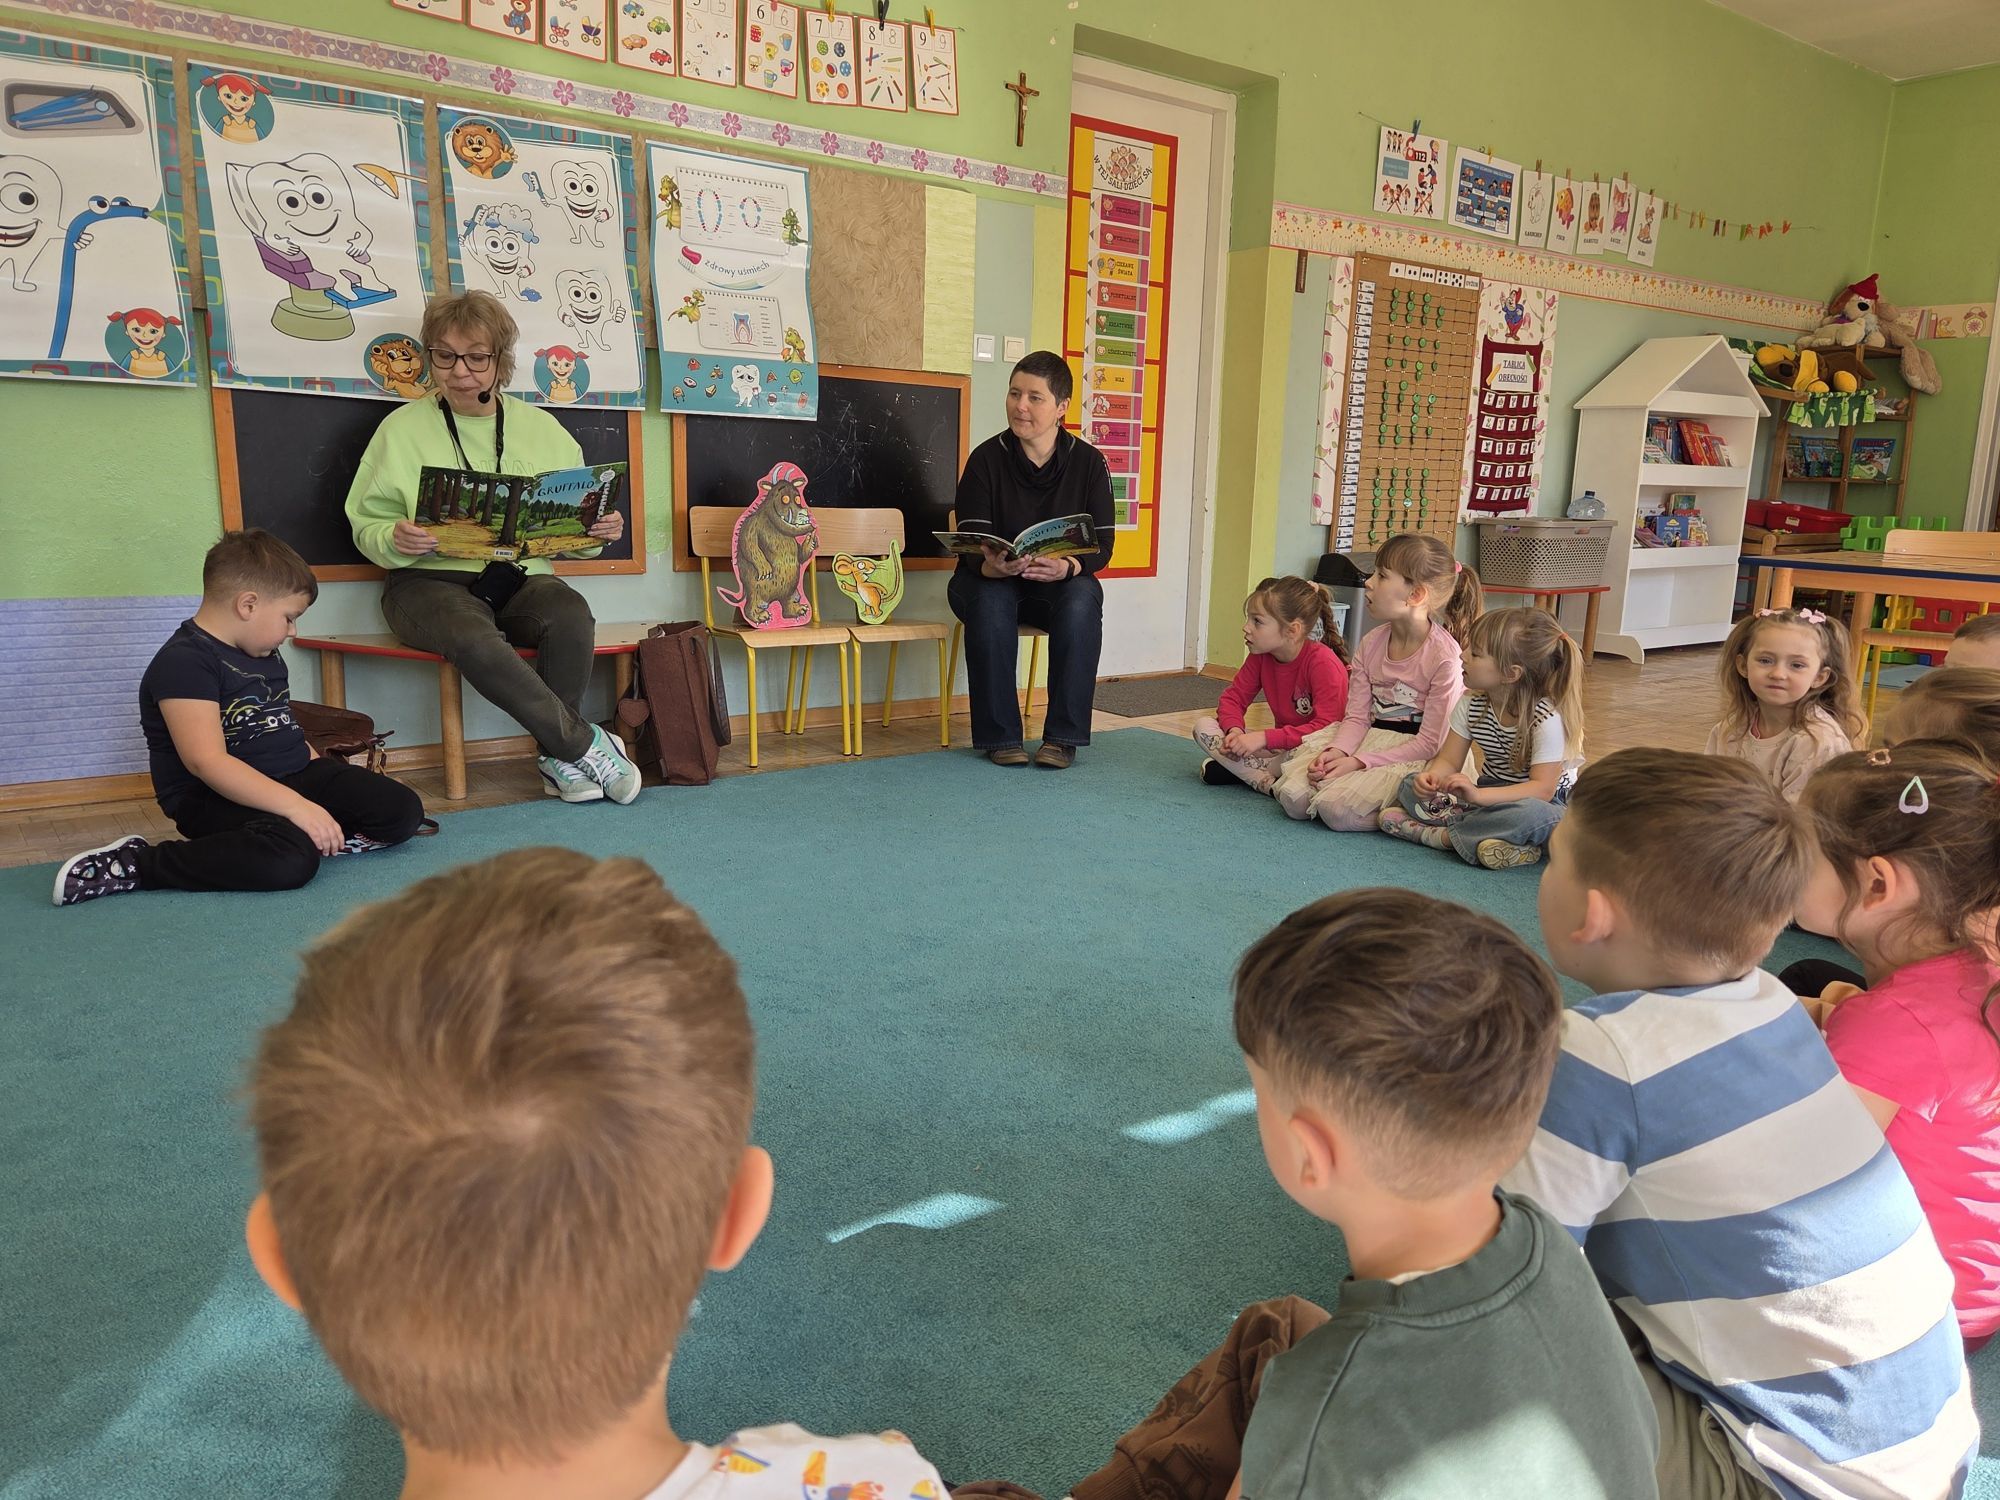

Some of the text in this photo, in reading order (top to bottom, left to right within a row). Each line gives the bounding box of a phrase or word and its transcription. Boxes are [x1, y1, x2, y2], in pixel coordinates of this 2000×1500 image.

[756, 4, 789, 27] 6 6
[815, 18, 845, 36] 7 7
[868, 25, 897, 45] 8 8
[919, 31, 947, 50] 9 9
[1415, 152, 1426, 162] 112
[1098, 164, 1109, 181] TEJ
[1108, 177, 1123, 191] SALI
[1124, 175, 1144, 191] DZIECI
[704, 259, 770, 278] zdrowy uśmiech
[1503, 360, 1526, 369] TABLICA
[1498, 373, 1528, 383] OBECNOŚCI
[537, 481, 595, 497] GRUFFALO
